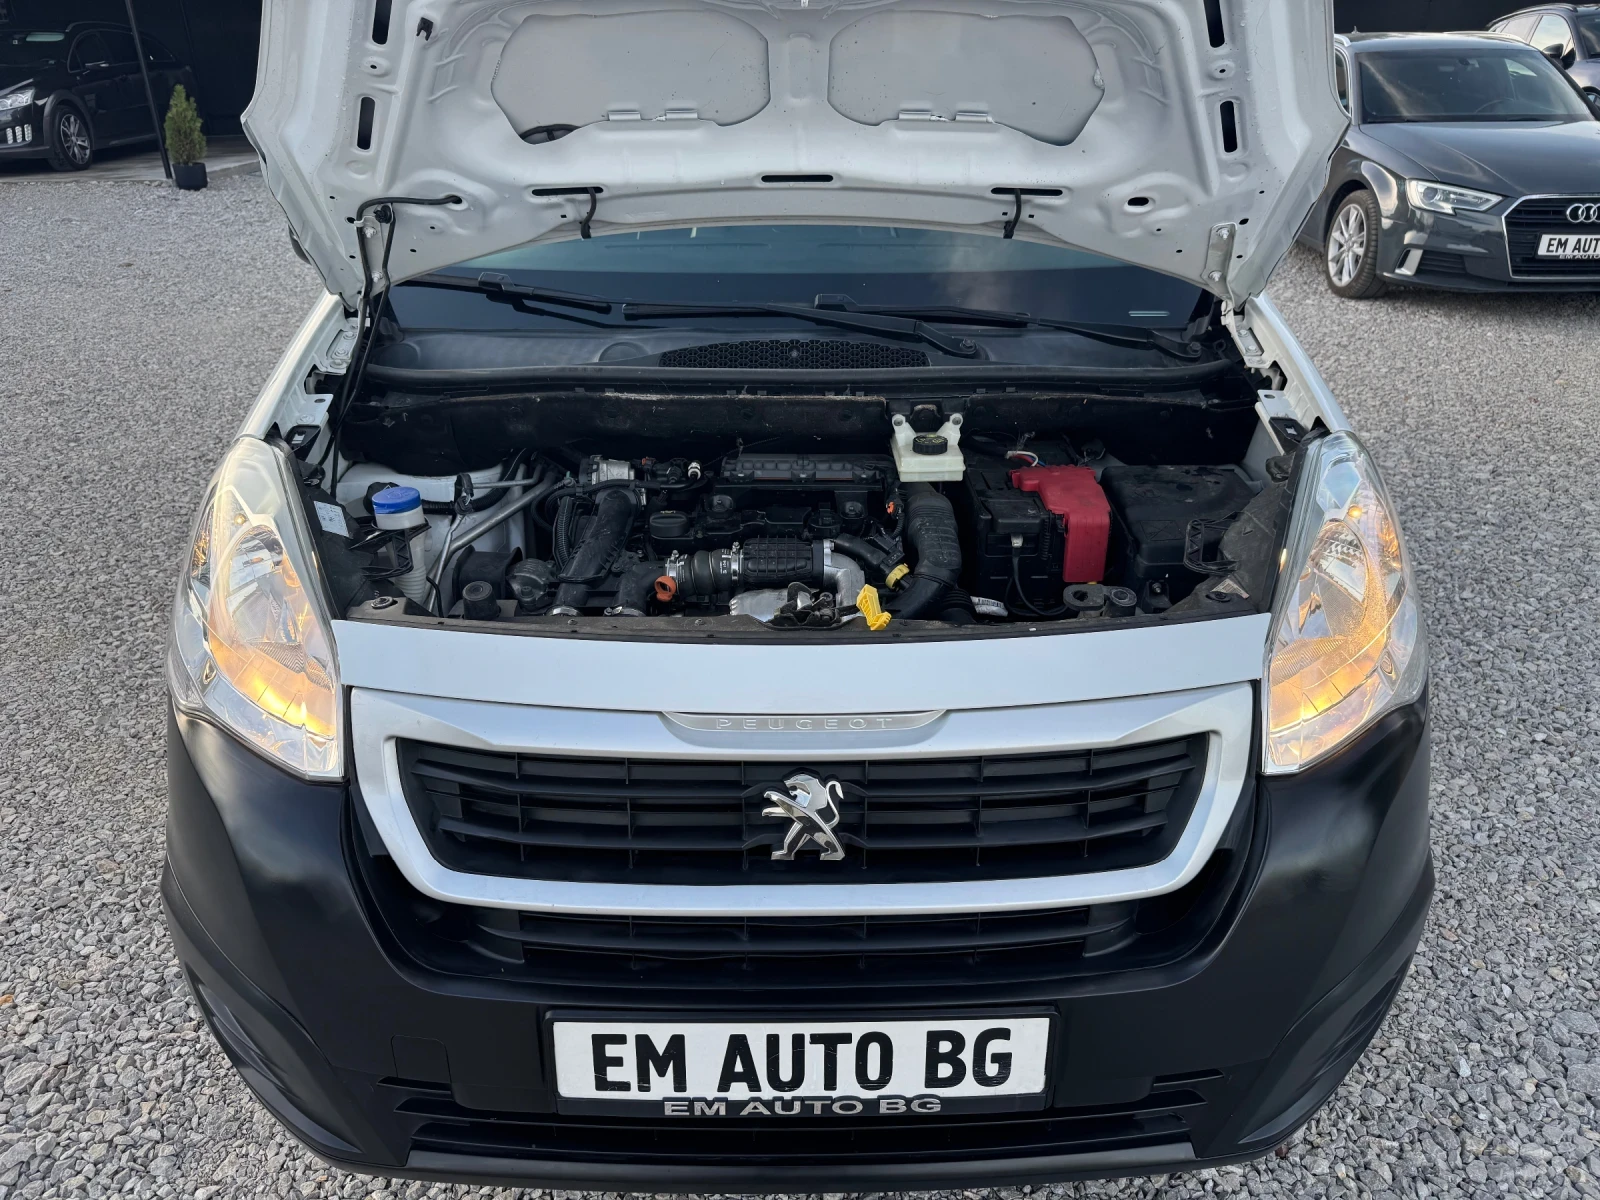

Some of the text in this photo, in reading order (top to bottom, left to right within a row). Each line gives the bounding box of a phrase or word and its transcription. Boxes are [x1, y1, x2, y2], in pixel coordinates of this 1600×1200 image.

[1546, 238, 1569, 253] EM
[716, 718, 892, 730] PEUGEOT
[591, 1027, 1013, 1093] EM AUTO BG
[663, 1098, 942, 1116] EM AUTO BG
